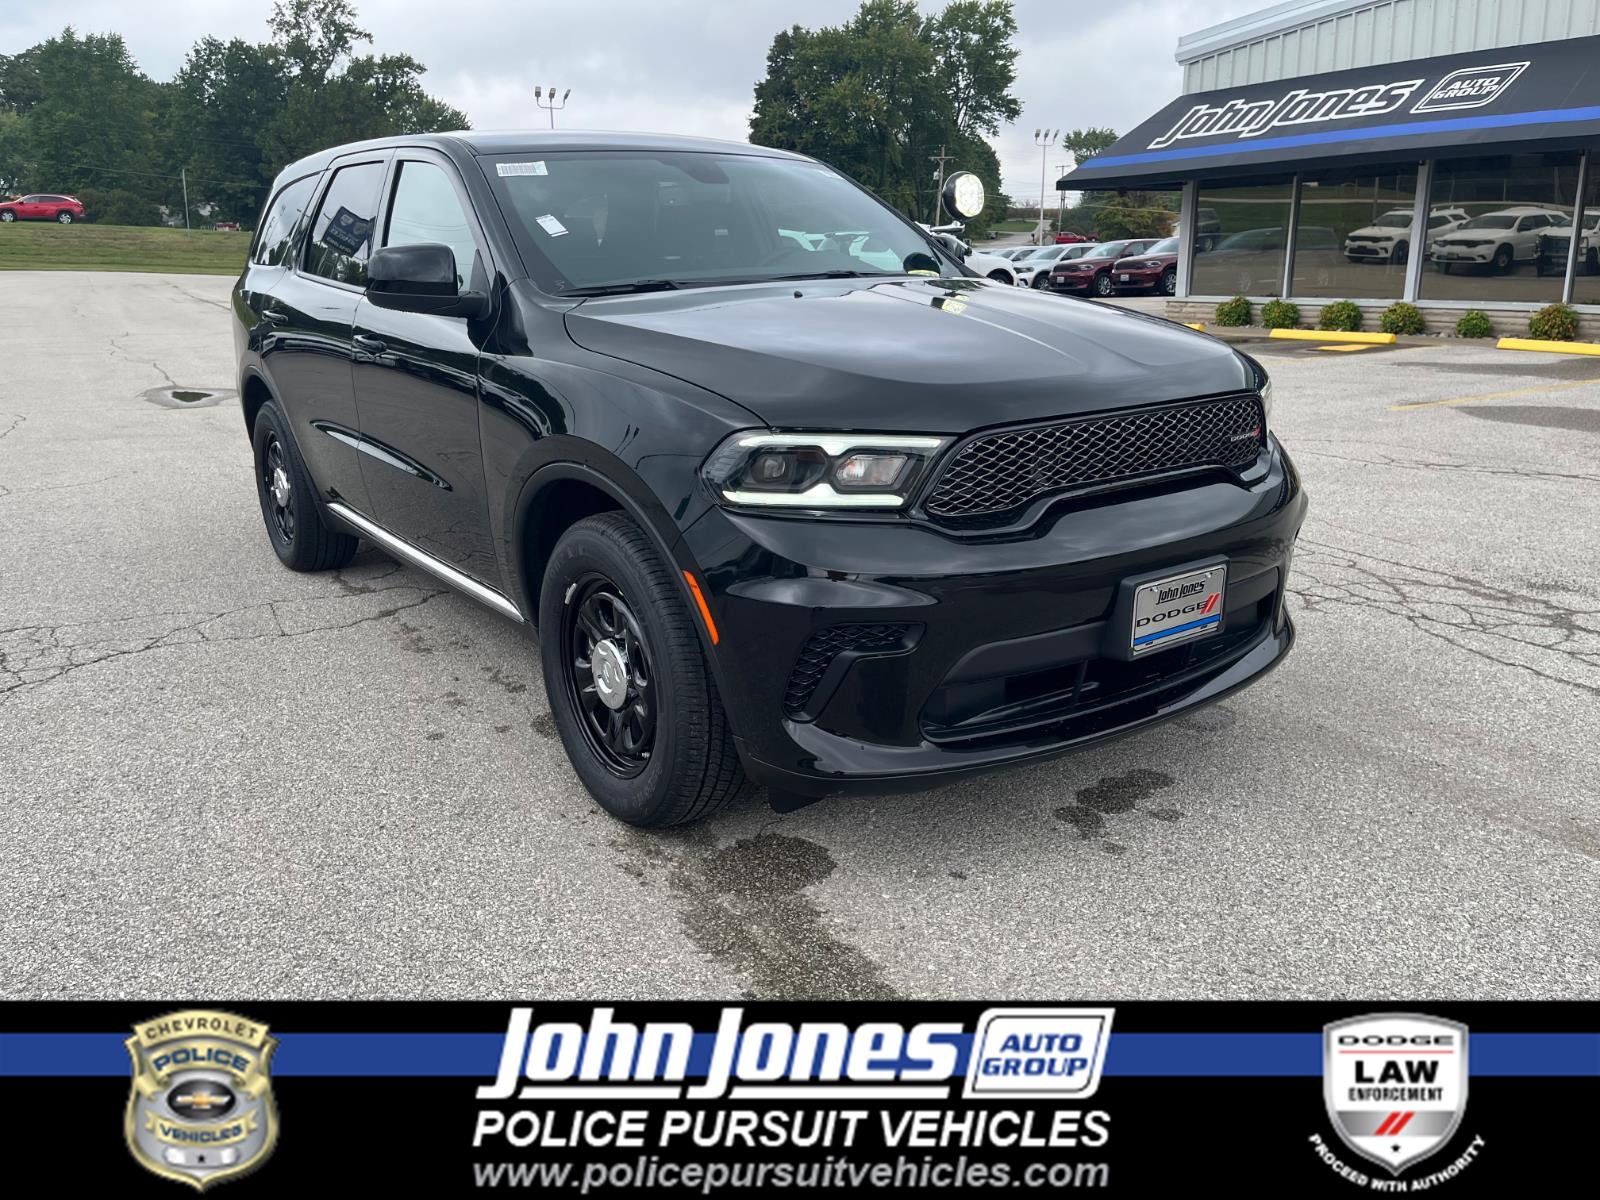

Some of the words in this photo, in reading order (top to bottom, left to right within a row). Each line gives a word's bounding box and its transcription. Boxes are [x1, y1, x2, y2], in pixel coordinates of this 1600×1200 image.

[1432, 85, 1498, 99] GROUP
[1446, 76, 1500, 91] AUTO
[1147, 99, 1275, 149] John
[1239, 79, 1425, 138] Jones
[1156, 586, 1179, 605] John
[1179, 580, 1206, 599] Jones
[1136, 600, 1209, 628] DODGE
